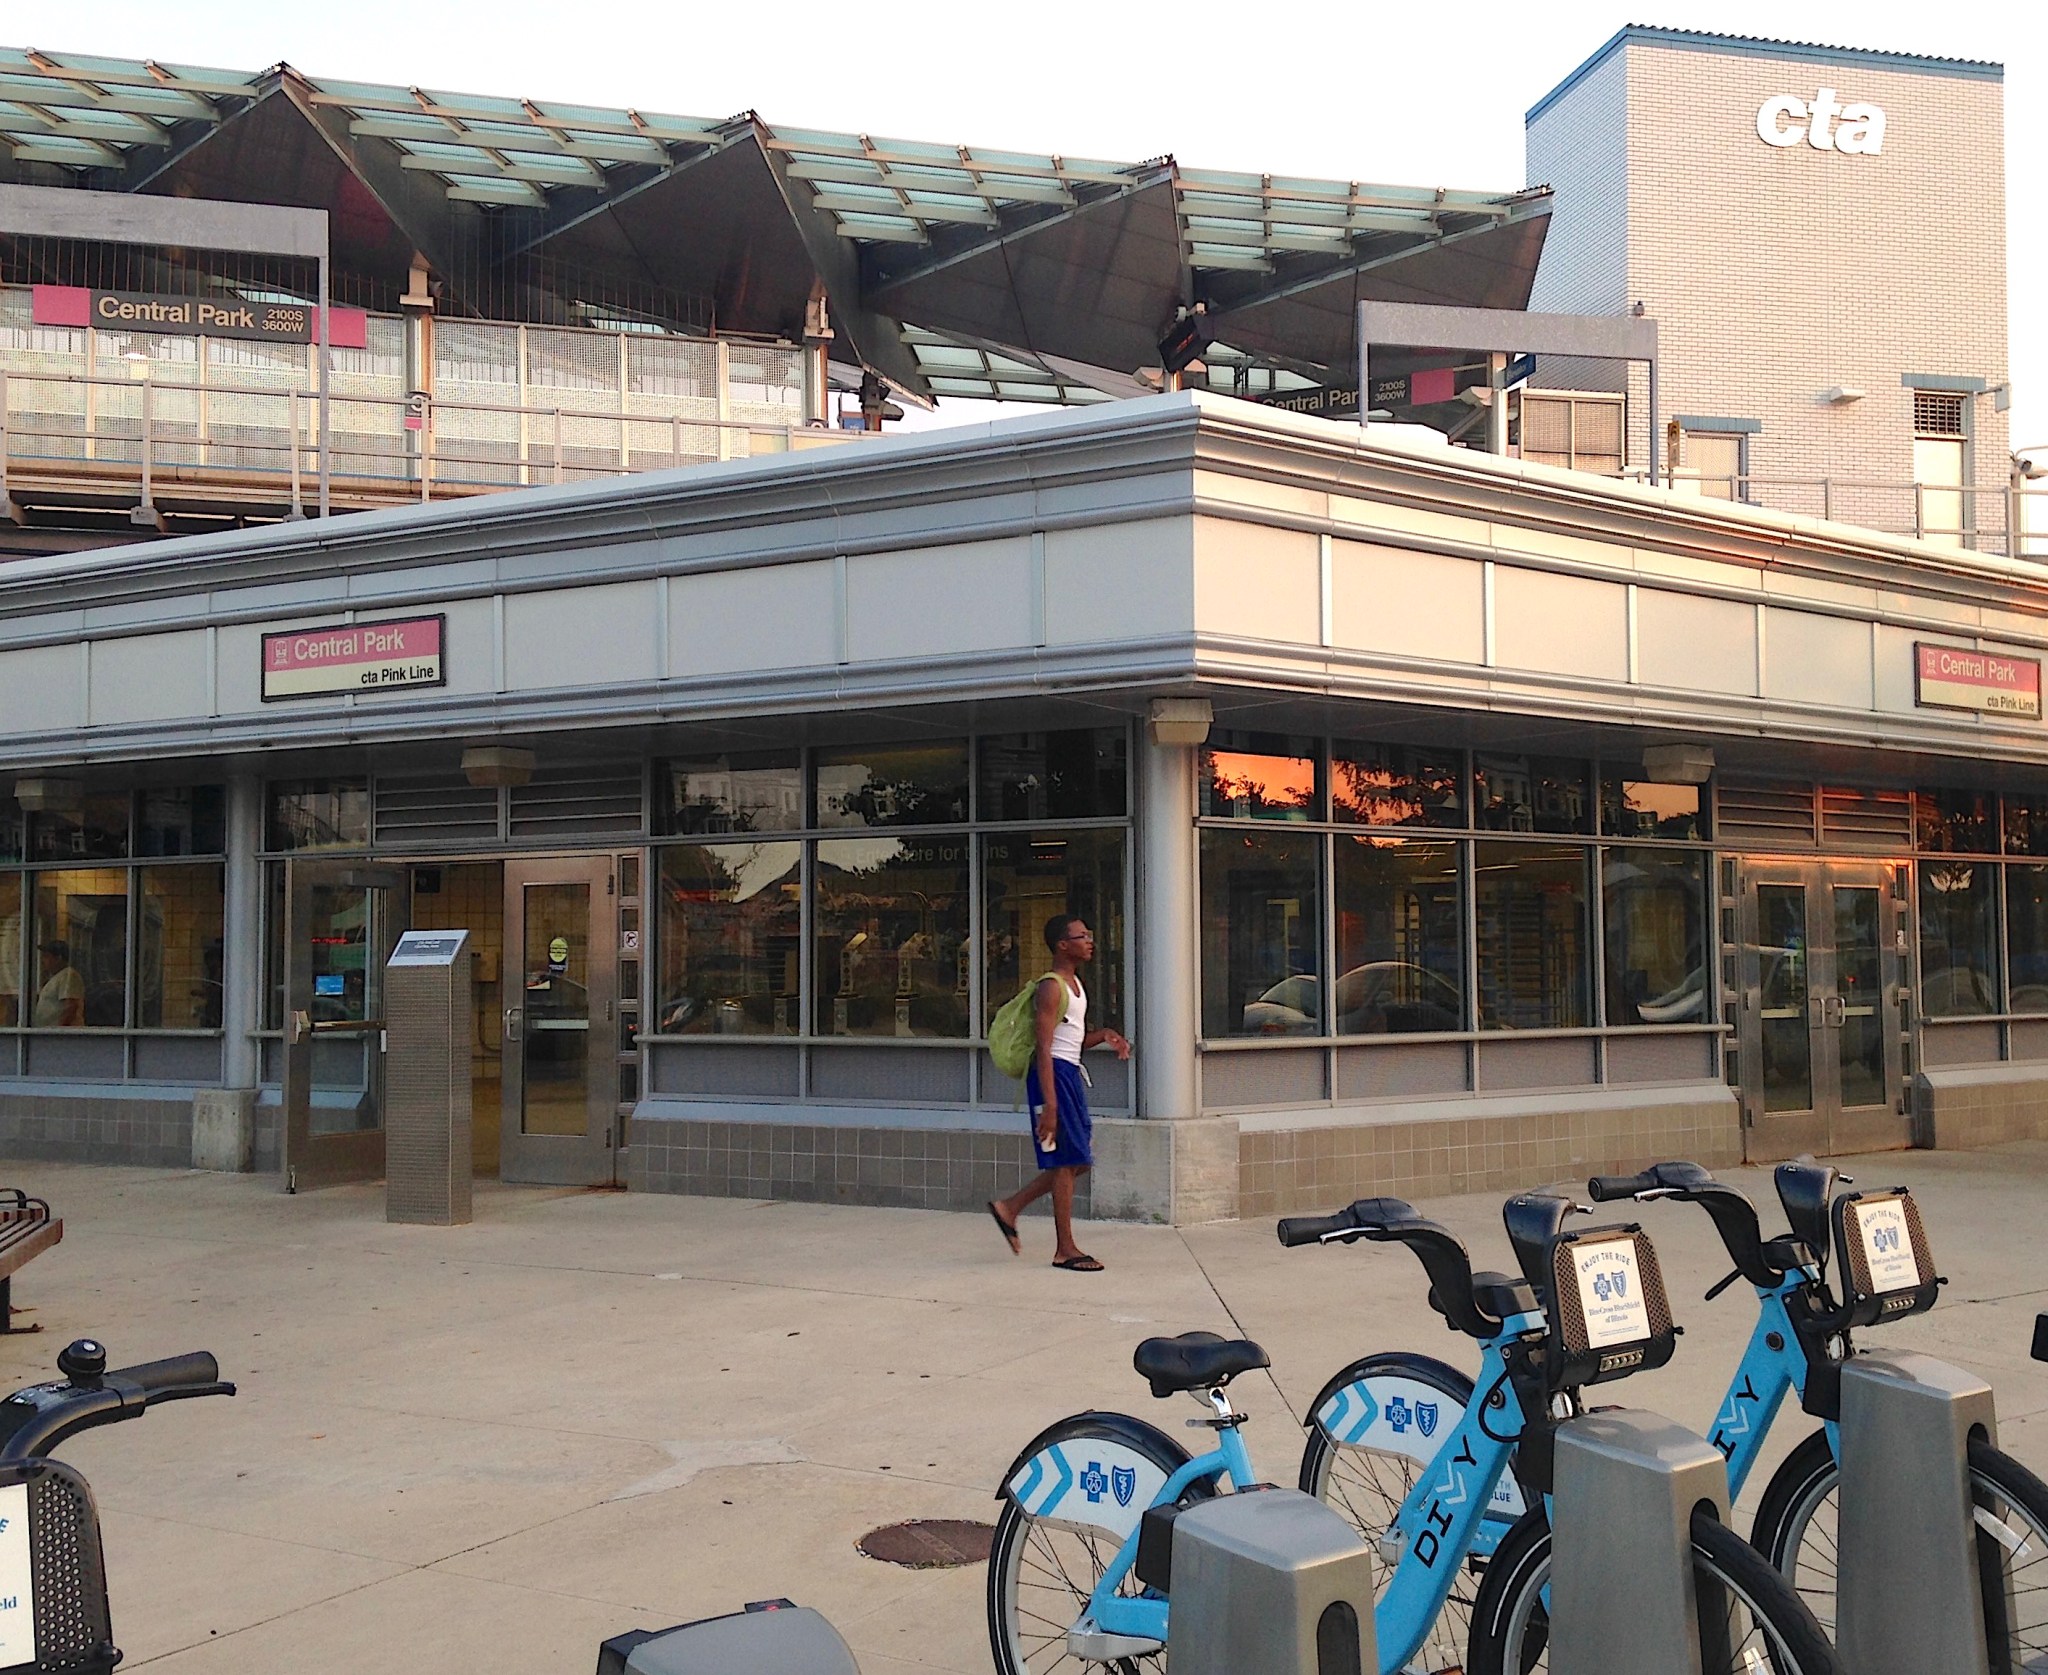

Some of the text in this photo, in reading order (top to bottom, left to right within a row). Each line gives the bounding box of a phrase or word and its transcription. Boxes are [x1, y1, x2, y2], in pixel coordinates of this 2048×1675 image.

[1756, 87, 1887, 156] cta
[99, 296, 255, 328] Central Park
[267, 308, 304, 321] 2100S
[262, 320, 304, 333] 3600W
[1378, 379, 1406, 392] 2100S
[1329, 389, 1360, 407] Par
[1374, 389, 1406, 402] 3600W
[294, 628, 405, 661] Central Park
[361, 665, 434, 684] cta Pink Line
[1940, 653, 2016, 682] Central Park
[1987, 696, 2035, 712] cta Pink Line
[938, 846, 960, 861] for
[1863, 1212, 1878, 1228] ENJOY
[1581, 1252, 1631, 1273] ENJOY THE RIDE
[1491, 1491, 1511, 1502] LUE
